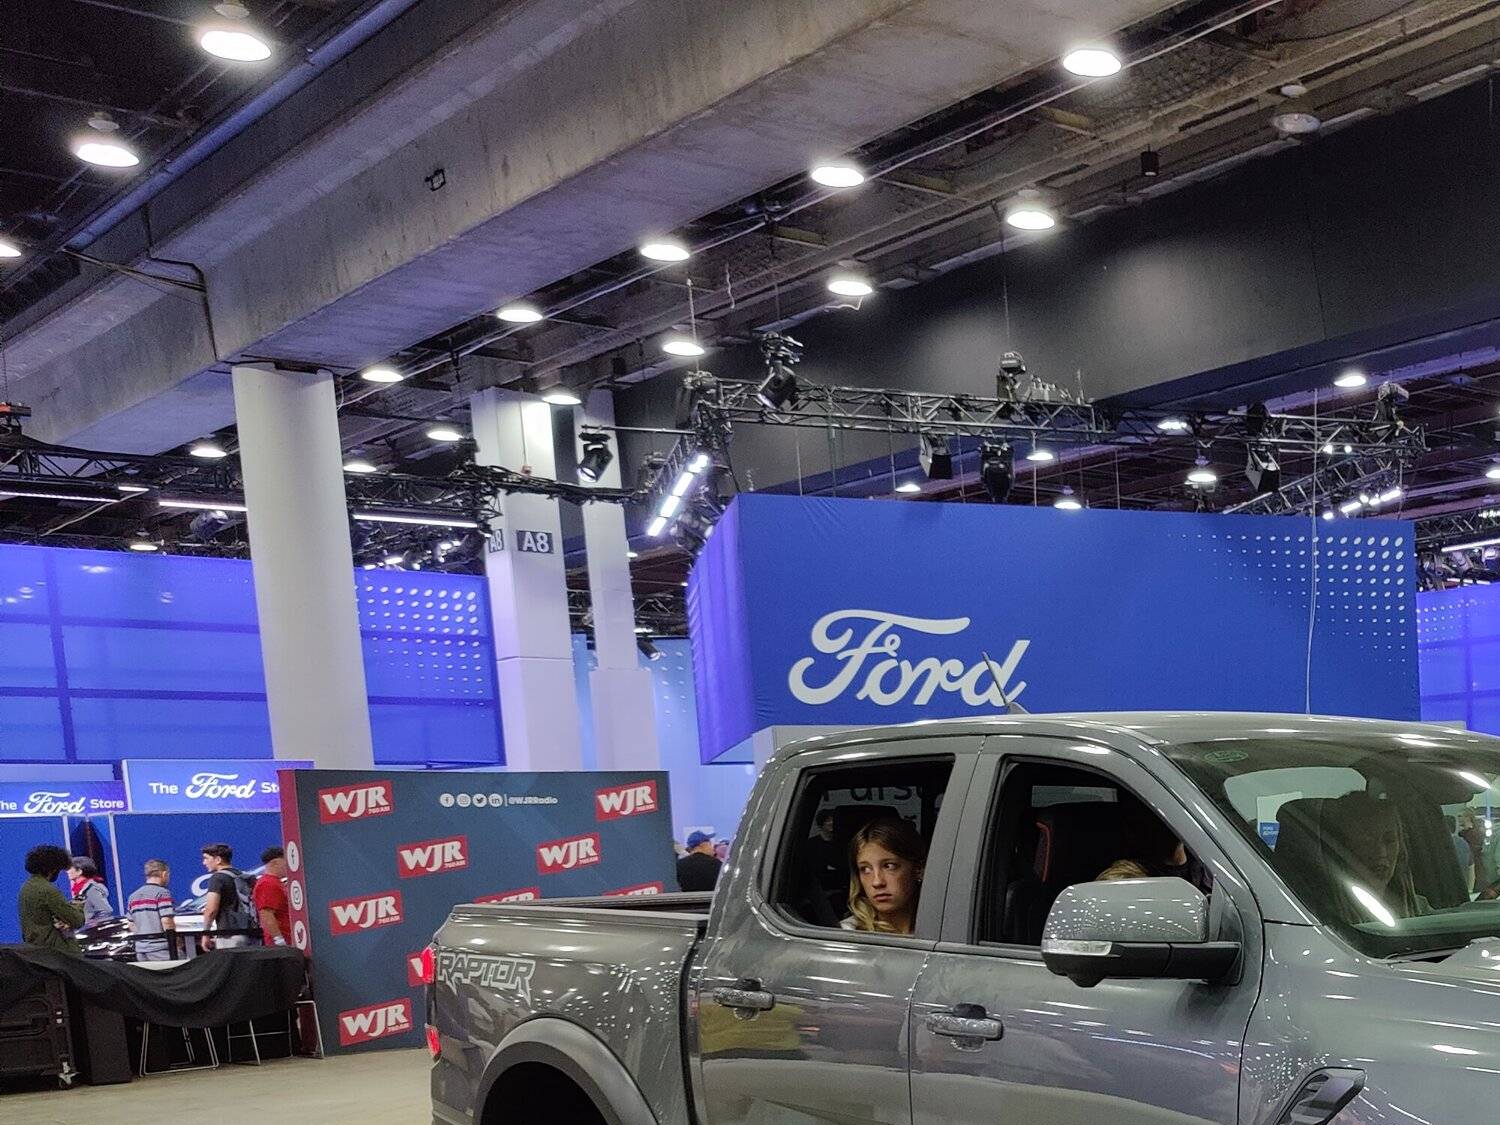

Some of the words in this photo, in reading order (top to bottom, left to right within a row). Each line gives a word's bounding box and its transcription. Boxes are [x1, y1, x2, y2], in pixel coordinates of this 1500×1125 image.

[489, 530, 503, 553] A8
[522, 531, 550, 553] A8
[788, 608, 1031, 707] Ford
[148, 782, 179, 795] The
[184, 772, 257, 799] Ford
[597, 785, 654, 816] WJR
[0, 801, 18, 812] he
[23, 791, 86, 814] Ford
[90, 798, 125, 809] Store
[322, 786, 389, 818] WJR
[400, 840, 465, 872] WJR
[539, 837, 598, 869] WJR
[331, 895, 399, 929] WJR
[437, 952, 537, 1008] RAPTOR
[342, 1003, 409, 1037] WJR
